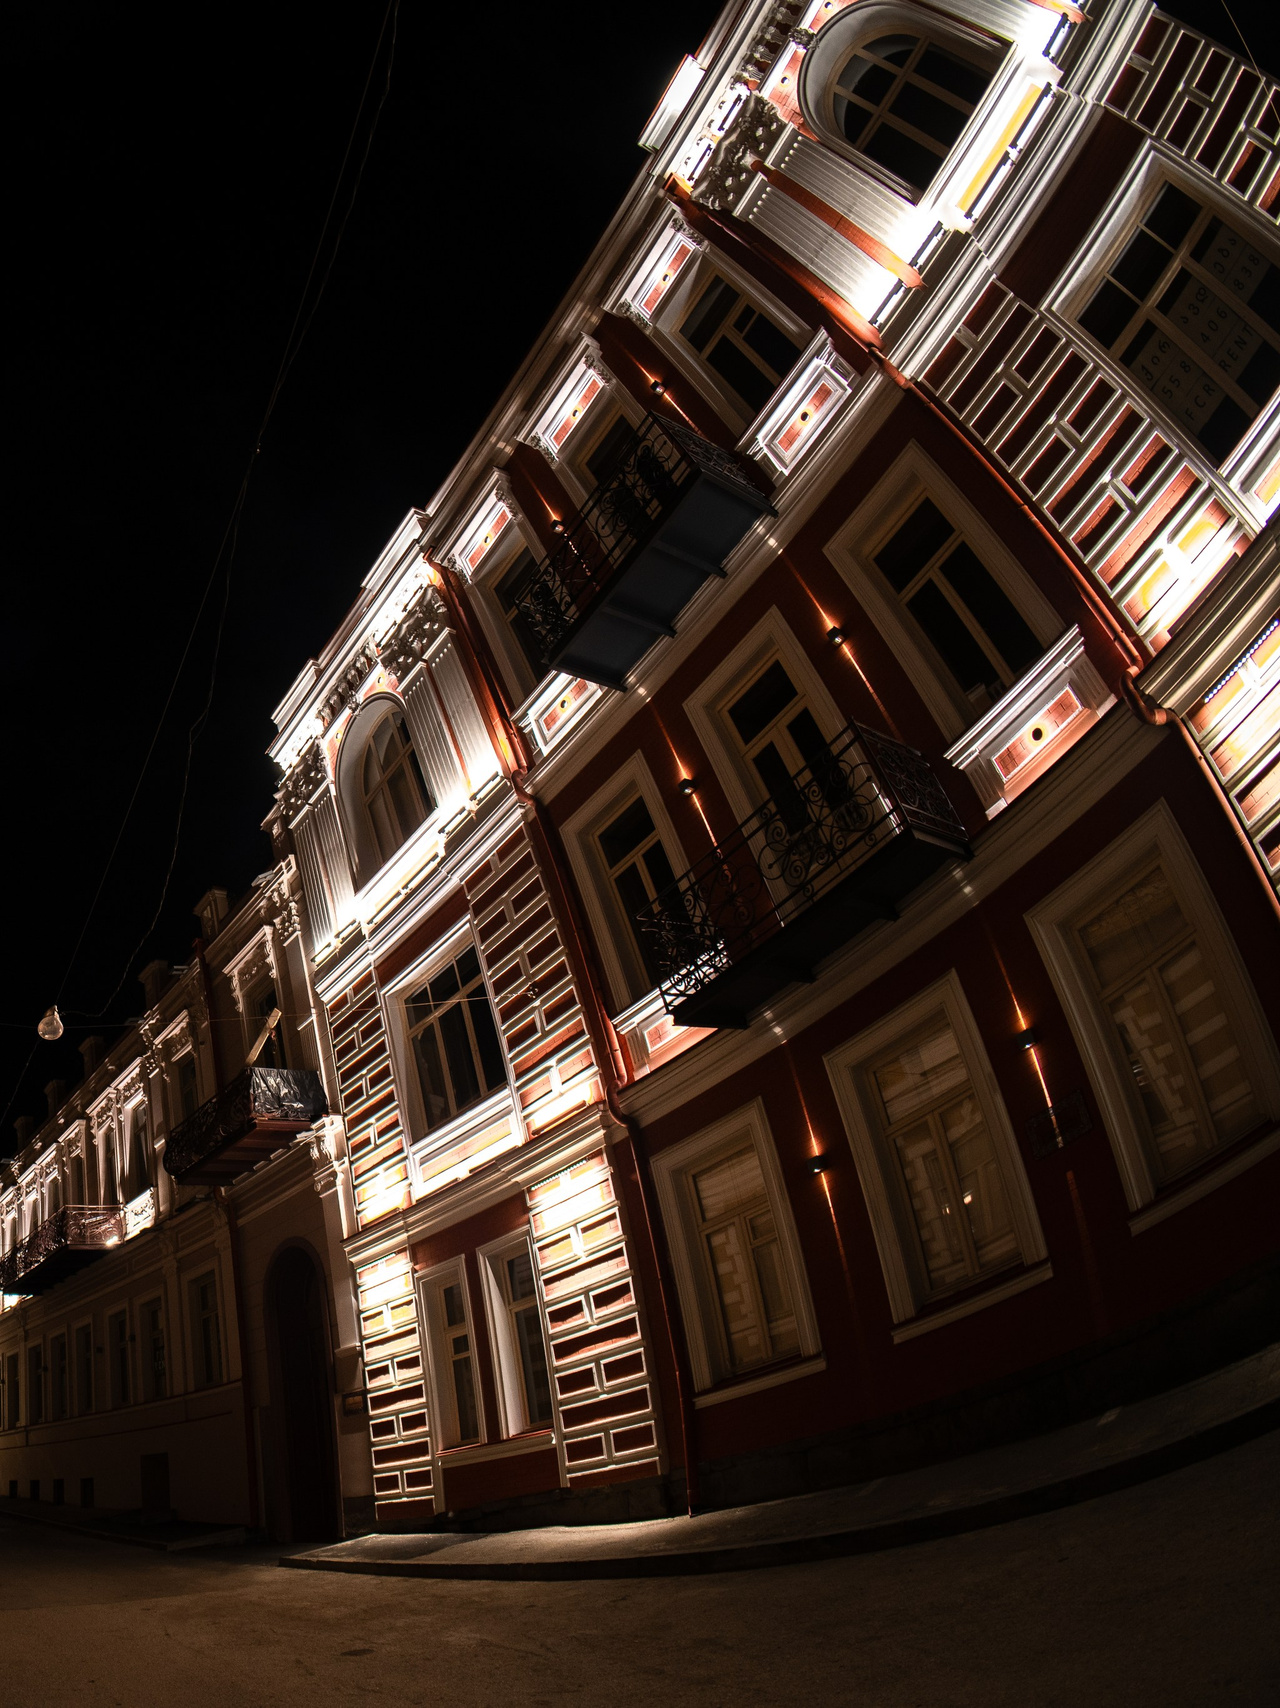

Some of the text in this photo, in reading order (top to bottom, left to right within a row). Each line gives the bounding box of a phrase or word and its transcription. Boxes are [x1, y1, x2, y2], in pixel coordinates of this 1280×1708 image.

[1162, 254, 1260, 399] 558 406 838
[1219, 324, 1254, 373] RENT
